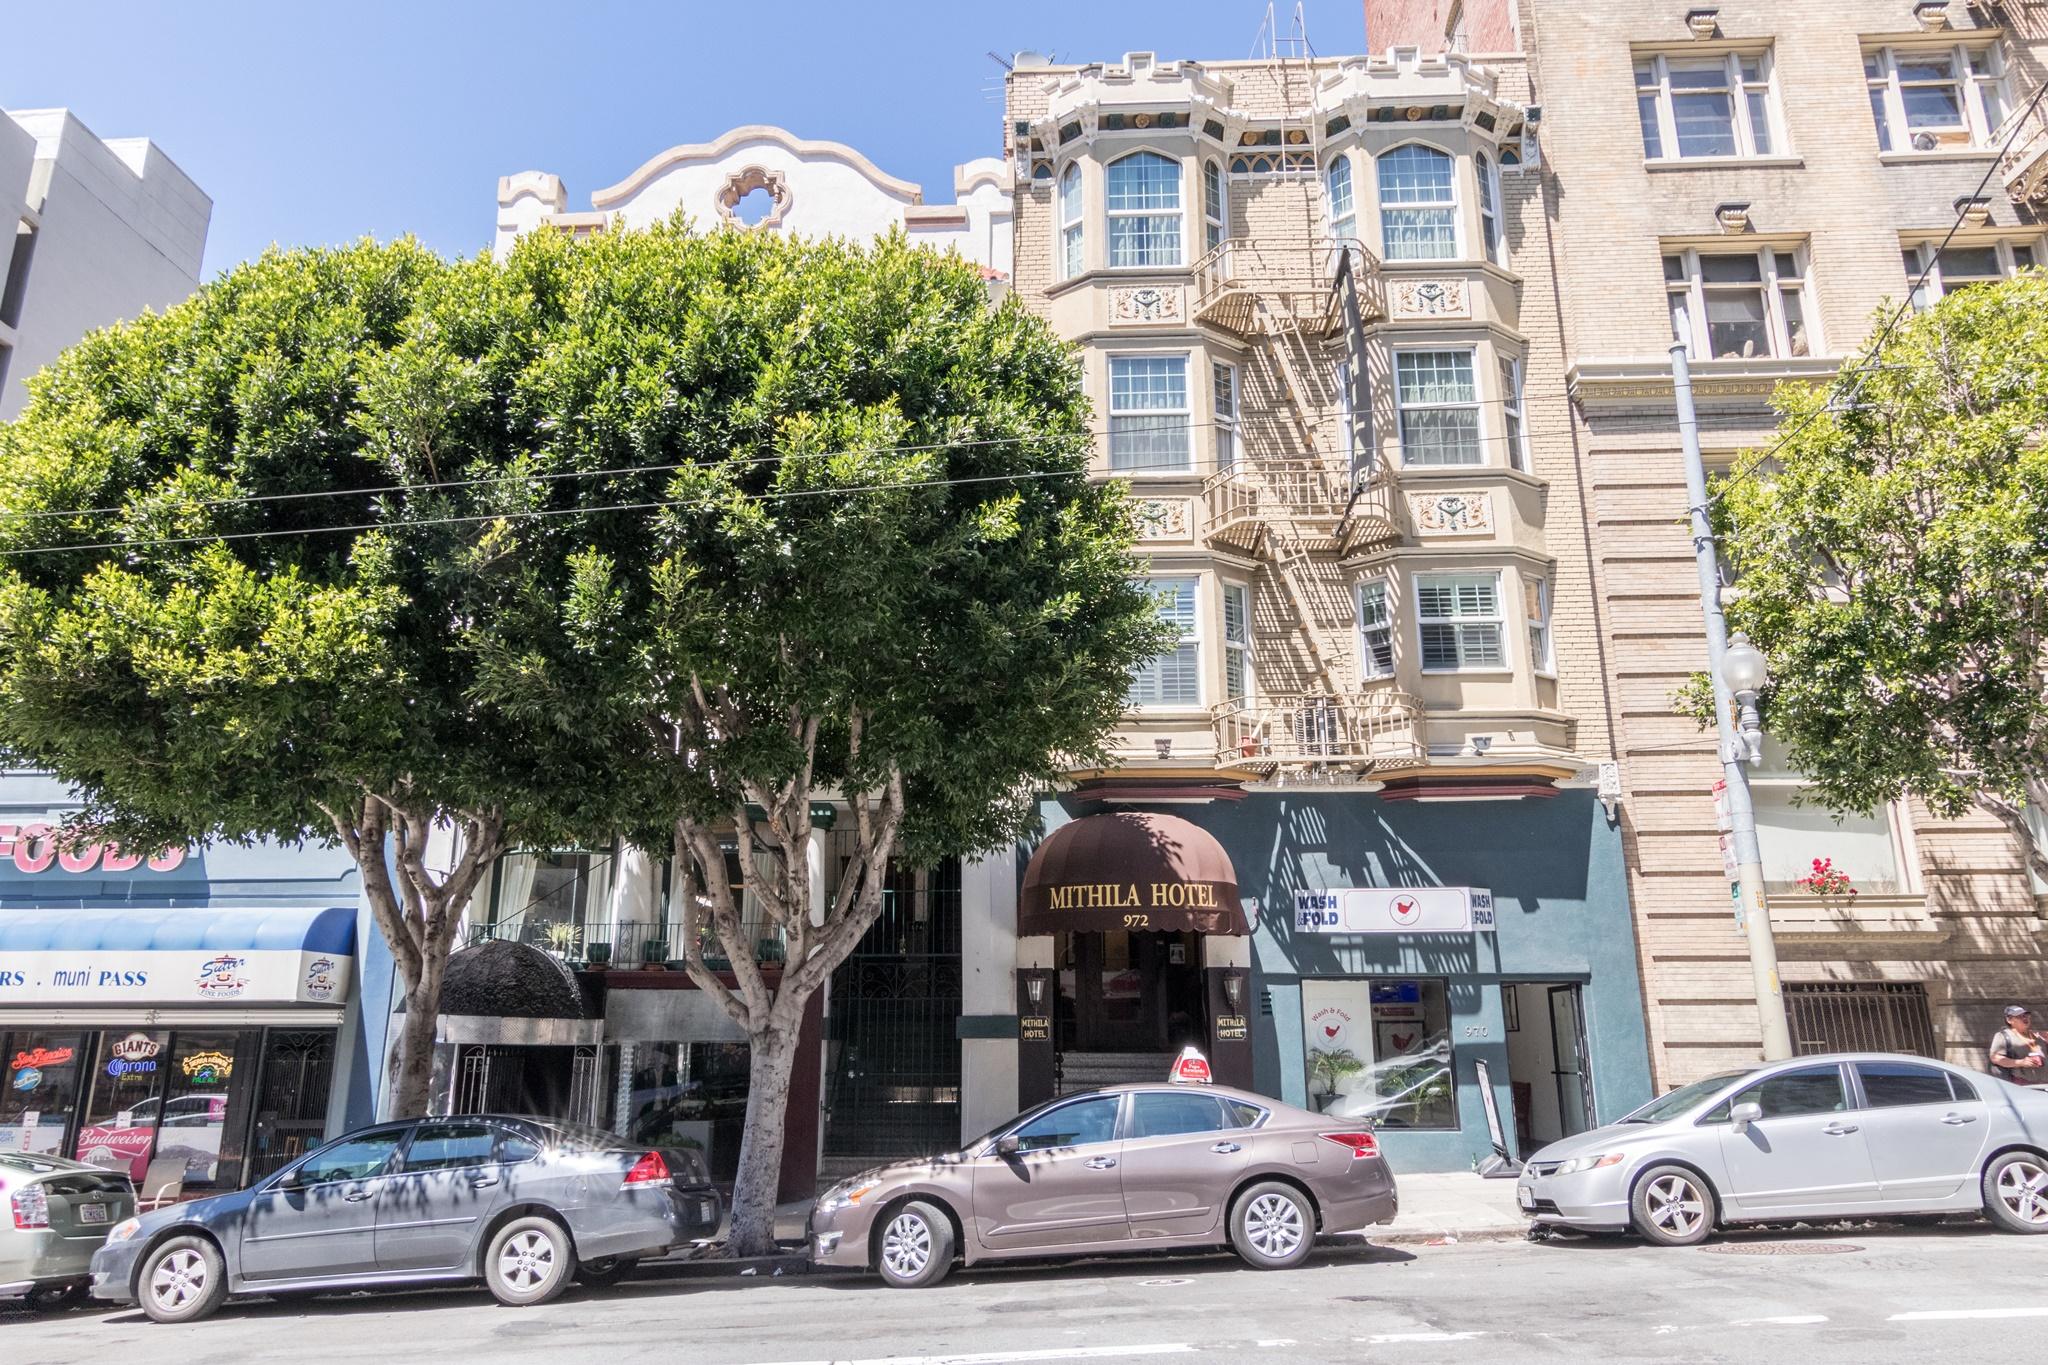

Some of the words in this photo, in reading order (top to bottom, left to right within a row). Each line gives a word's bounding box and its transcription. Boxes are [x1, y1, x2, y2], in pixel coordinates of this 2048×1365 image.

[1050, 884, 1141, 910] MITHILA
[1151, 883, 1218, 908] HOTEL
[1298, 895, 1338, 910] WASH
[1471, 894, 1491, 909] WASH
[1123, 914, 1149, 928] 972
[200, 957, 246, 978] Sutter
[53, 965, 91, 987] muni
[98, 970, 148, 987] PASS
[1217, 1018, 1245, 1027] MITHILA
[1312, 1008, 1329, 1022] Wash
[1336, 1008, 1352, 1022] Fold
[1021, 1019, 1049, 1027] MITHILA
[1024, 1029, 1047, 1039] HOTEL
[1220, 1029, 1243, 1038] HOTEL
[114, 1041, 158, 1056] GIANTS
[107, 1059, 157, 1077] Corona
[79, 1129, 153, 1146] Budweiser
